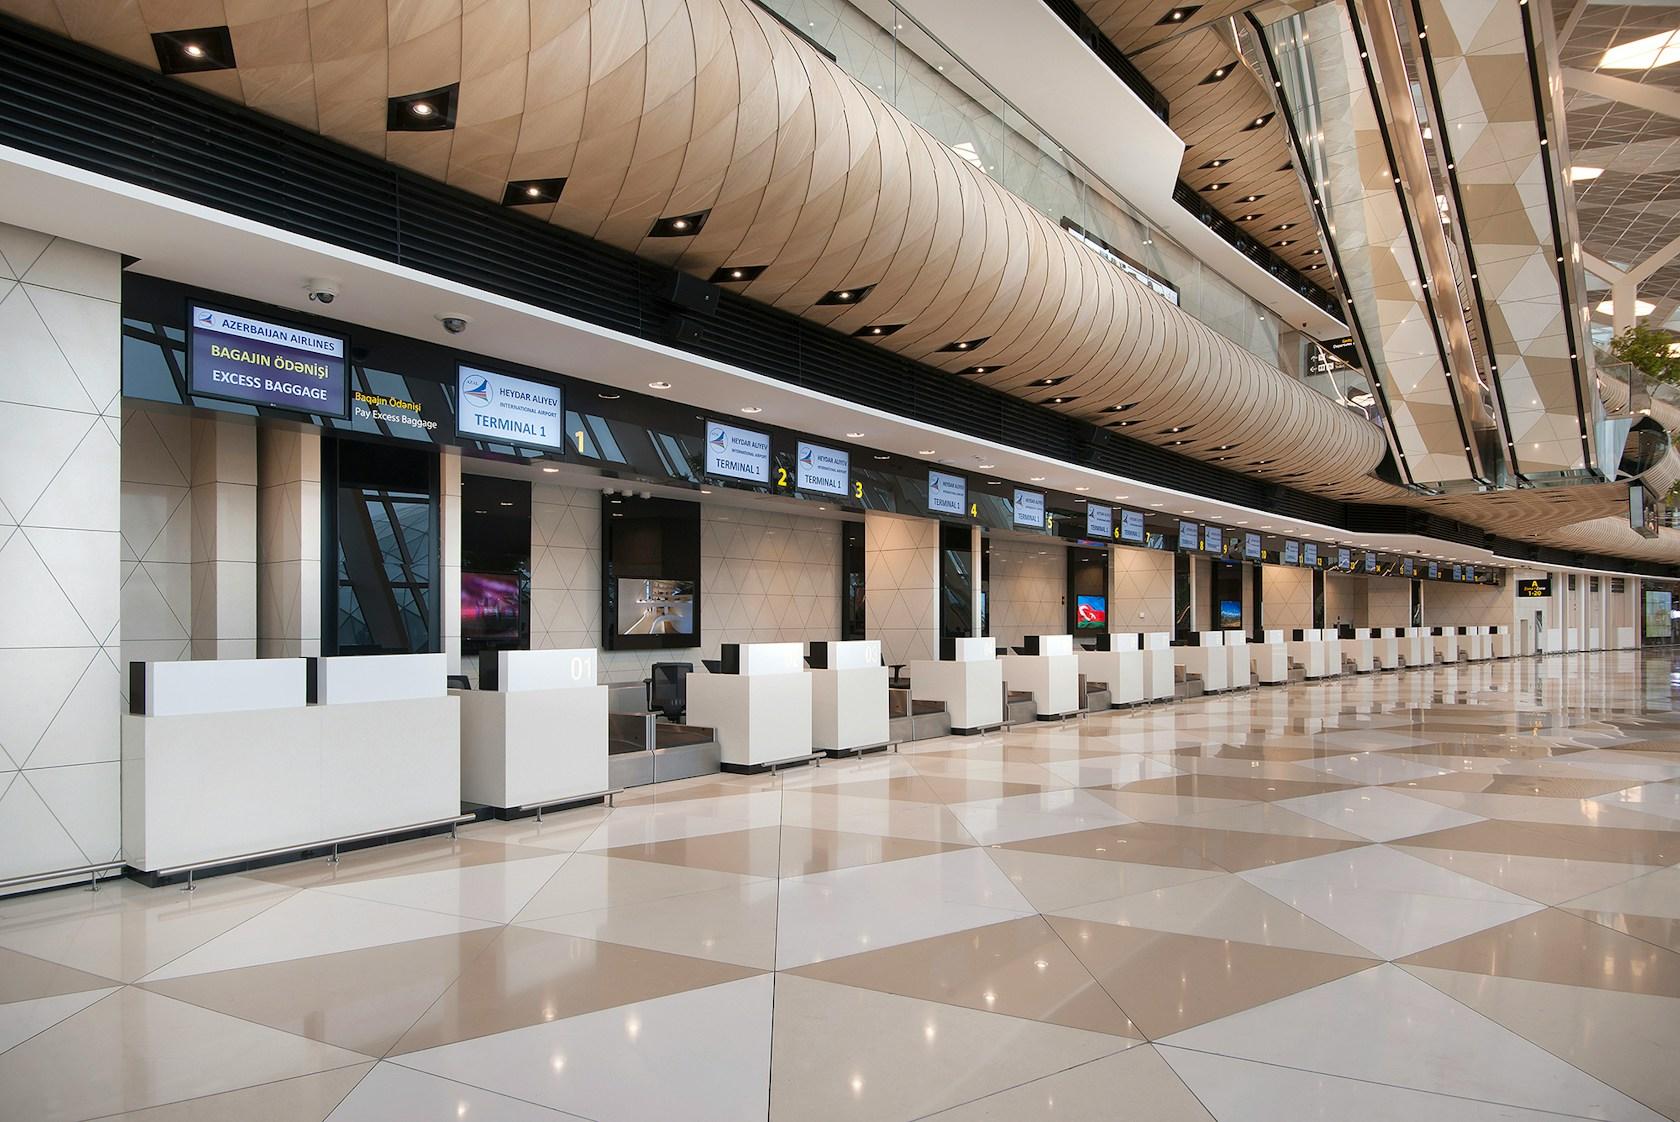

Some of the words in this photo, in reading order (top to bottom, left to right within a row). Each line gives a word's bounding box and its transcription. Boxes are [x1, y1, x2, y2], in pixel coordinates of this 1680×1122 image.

[222, 319, 288, 341] AZERBAIJAN
[290, 334, 335, 351] AIRLINES
[211, 344, 271, 367] BAGAJIN
[274, 355, 329, 380] ÖDƏNİŞİ
[212, 369, 262, 389] EXCESS
[265, 379, 328, 401] BAGGAGE
[499, 387, 531, 402] HEYDAR
[532, 394, 558, 407] ALIYEV
[355, 407, 371, 420] Pay
[372, 409, 400, 423] Excess
[401, 414, 438, 430] Baggage
[499, 402, 537, 414] INTERNATIONAL
[537, 409, 557, 418] AIRPORT
[474, 413, 537, 436] TERMINAL
[540, 426, 547, 437] 1
[575, 430, 584, 453] 1
[731, 436, 751, 447] HEYDAR
[716, 458, 755, 475] TERMINAL
[756, 466, 760, 475] 1
[777, 467, 788, 487] 2
[804, 474, 836, 488] TERMINAL
[837, 480, 842, 489] 1
[855, 481, 863, 499] 3
[970, 503, 978, 518] 4
[1114, 527, 1120, 539] 6
[1145, 532, 1151, 543] 7
[570, 656, 592, 680] 01
